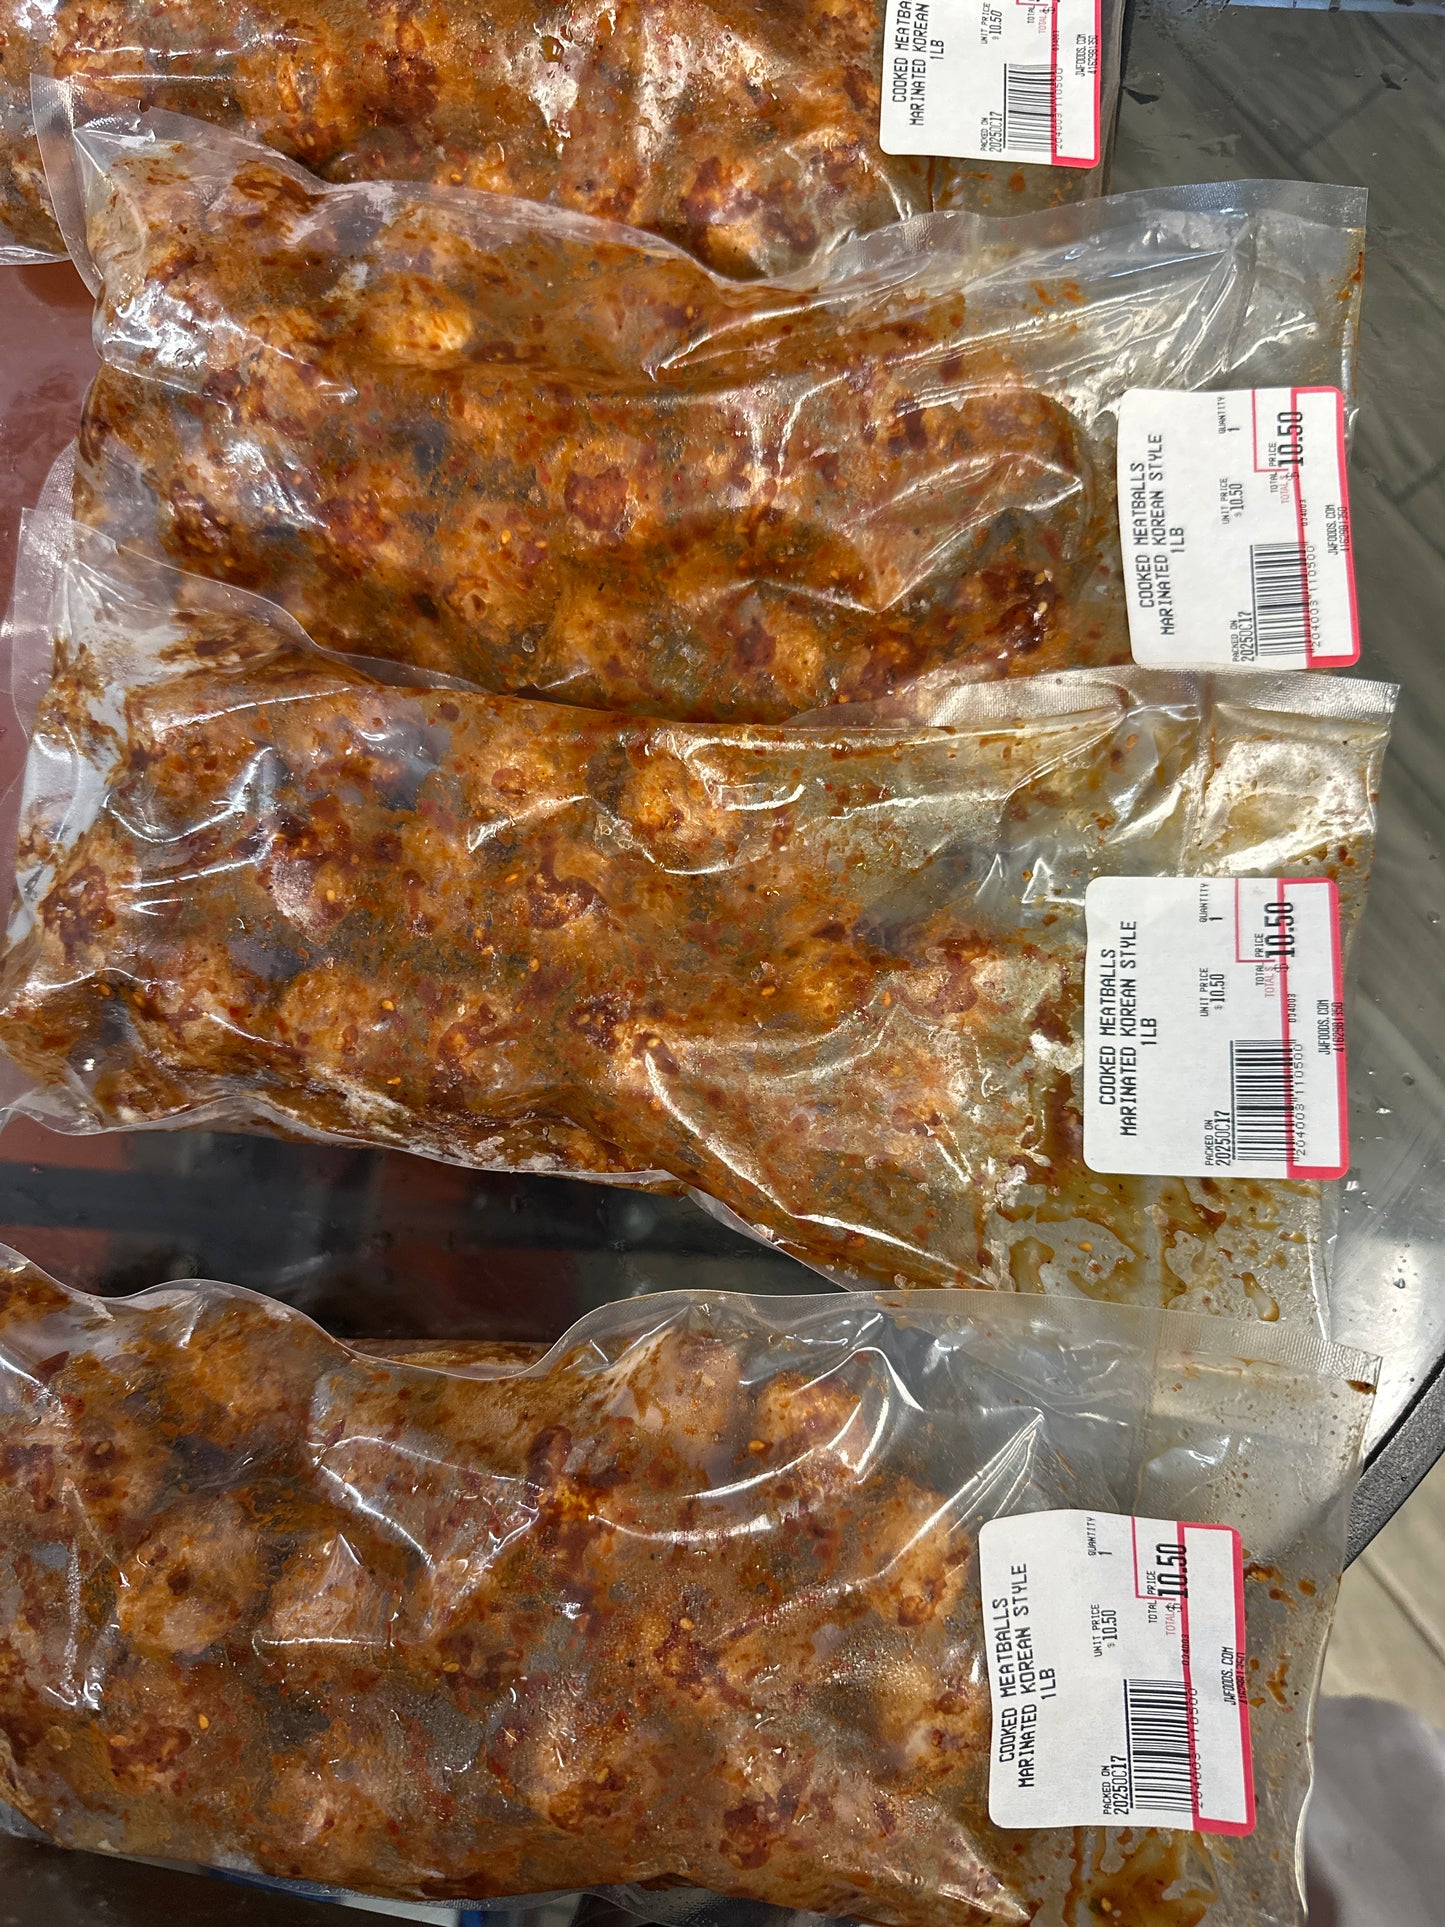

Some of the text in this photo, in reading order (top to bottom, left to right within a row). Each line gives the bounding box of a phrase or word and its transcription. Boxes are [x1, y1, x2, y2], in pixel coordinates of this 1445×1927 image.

[982, 2, 990, 26] PRICE
[892, 0, 911, 102] COOKED MEATBA
[910, 3, 929, 126] MARINATED KOREAN
[930, 40, 944, 60] 1LB
[980, 117, 988, 151] PACKED ON
[1217, 396, 1226, 434] QUANTITY
[1268, 443, 1278, 493] TOTAL PRICE
[1219, 478, 1229, 524] UNIT PRICE
[1130, 462, 1154, 608] COOKED MEATBALLS
[1147, 434, 1175, 635] MARINATED KOREAN STYLE
[1170, 527, 1185, 554] 1LB
[1230, 620, 1239, 662] PACKED ON
[1200, 882, 1209, 923] QUANTITY
[1254, 933, 1264, 986] TOTAL PRICE
[1200, 968, 1208, 1016] UNIT PRICE
[1264, 974, 1275, 998] TOTAL
[1099, 948, 1116, 1105] COOKED MEATBALLS
[1120, 920, 1137, 1136] MARINATED KOREAN STYLE
[1140, 1018, 1156, 1046] 1LB
[1332, 1002, 1344, 1052] 4162981350
[1294, 1044, 1306, 1156] 204003 110500
[1204, 1119, 1214, 1166] PACKED ON
[1086, 1516, 1097, 1556] QUANTITY
[1146, 1570, 1158, 1624] TOTAL PRICE
[1091, 1604, 1102, 1657] UNIT PRICE
[1165, 1611, 1176, 1635] TOTAL
[992, 1597, 1018, 1762] COOKED MEATBALLS
[1011, 1563, 1037, 1787] MARINATED KOREAN STYLE
[1040, 1667, 1056, 1700] 1LB
[1101, 1765, 1111, 1815] PACKED ON
